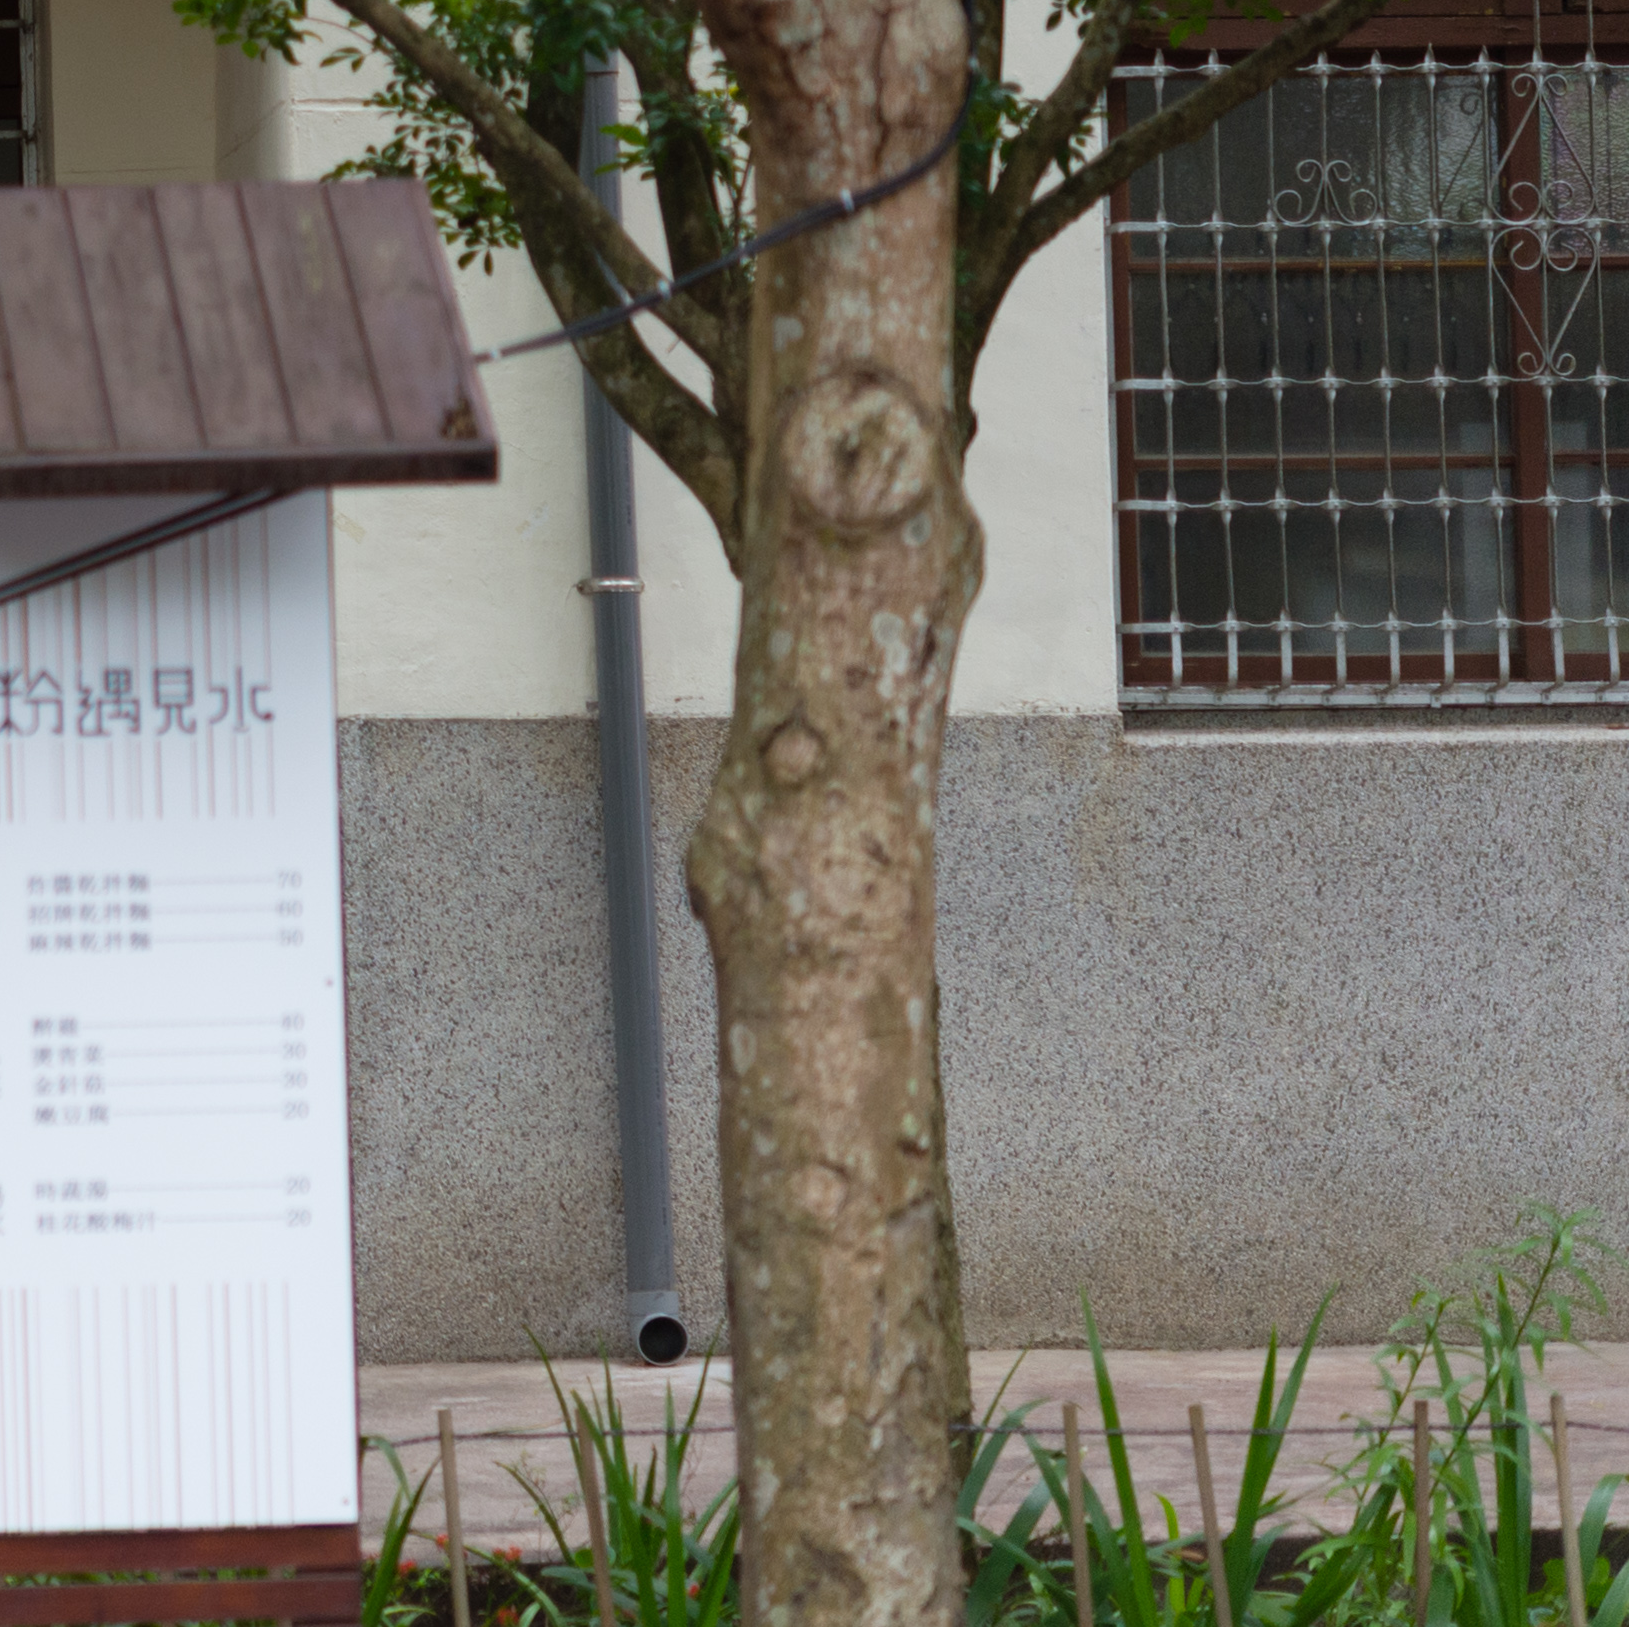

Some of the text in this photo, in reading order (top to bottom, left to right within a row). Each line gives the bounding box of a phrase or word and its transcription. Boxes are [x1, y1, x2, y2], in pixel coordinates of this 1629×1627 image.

[277, 870, 303, 890] 70
[284, 1101, 309, 1120] 20
[286, 1176, 311, 1195] 20
[288, 1209, 312, 1228] 20
